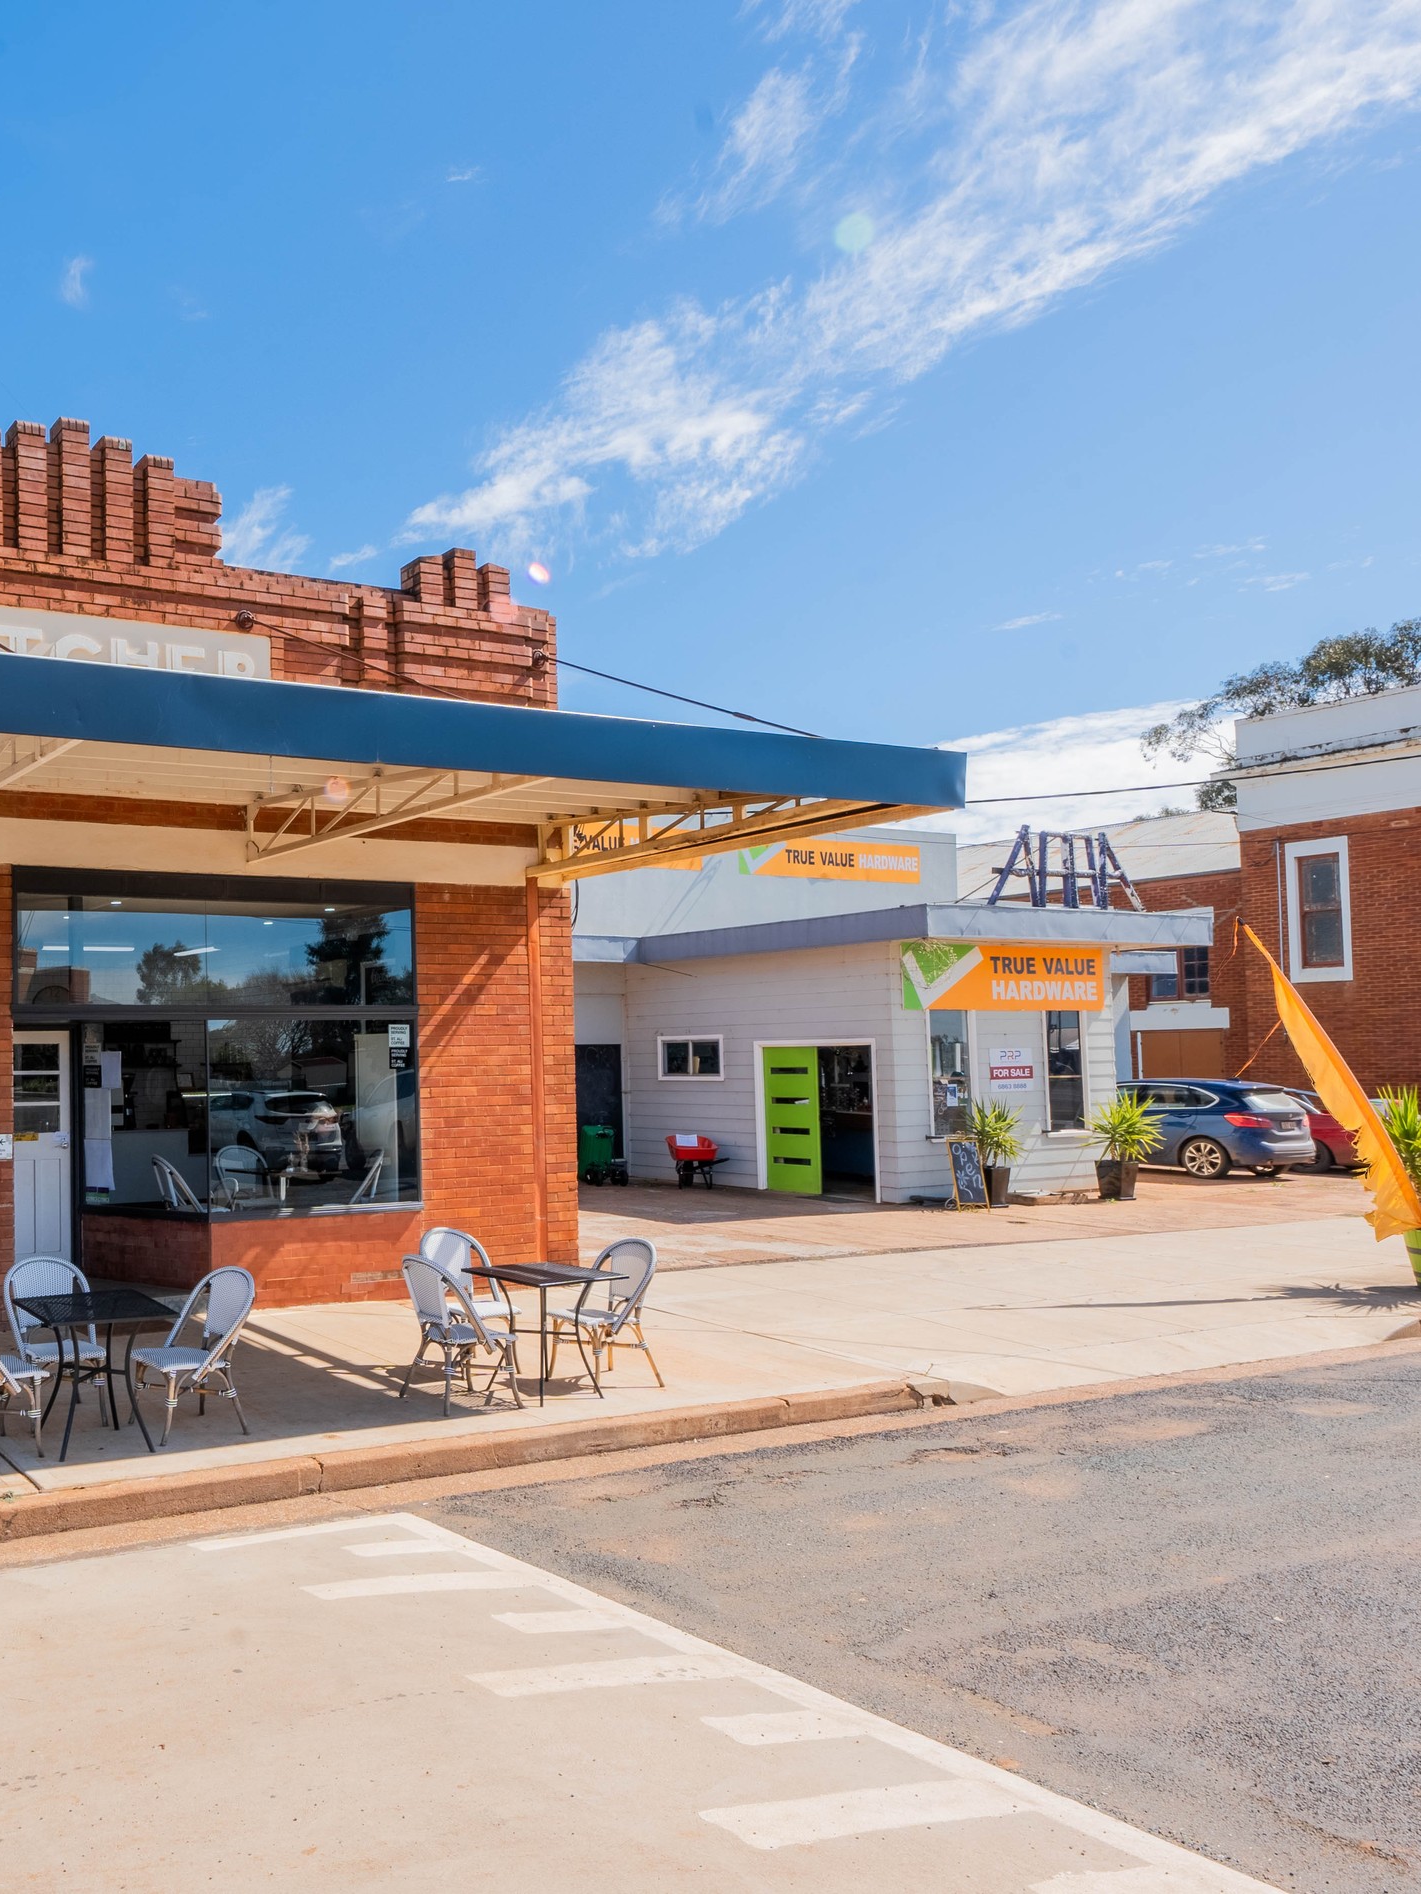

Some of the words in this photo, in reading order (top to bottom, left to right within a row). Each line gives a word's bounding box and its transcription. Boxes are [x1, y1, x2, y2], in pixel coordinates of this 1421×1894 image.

[785, 849, 815, 865] TRUE
[820, 851, 855, 868] VALUE
[858, 853, 918, 872] HARDWARE
[990, 956, 1036, 974] TRUE
[1042, 957, 1096, 976] VALUE
[991, 980, 1098, 1001] HARDWARE
[1000, 1050, 1021, 1060] PRP
[993, 1069, 1009, 1077] FOR
[1010, 1068, 1031, 1077] SALE
